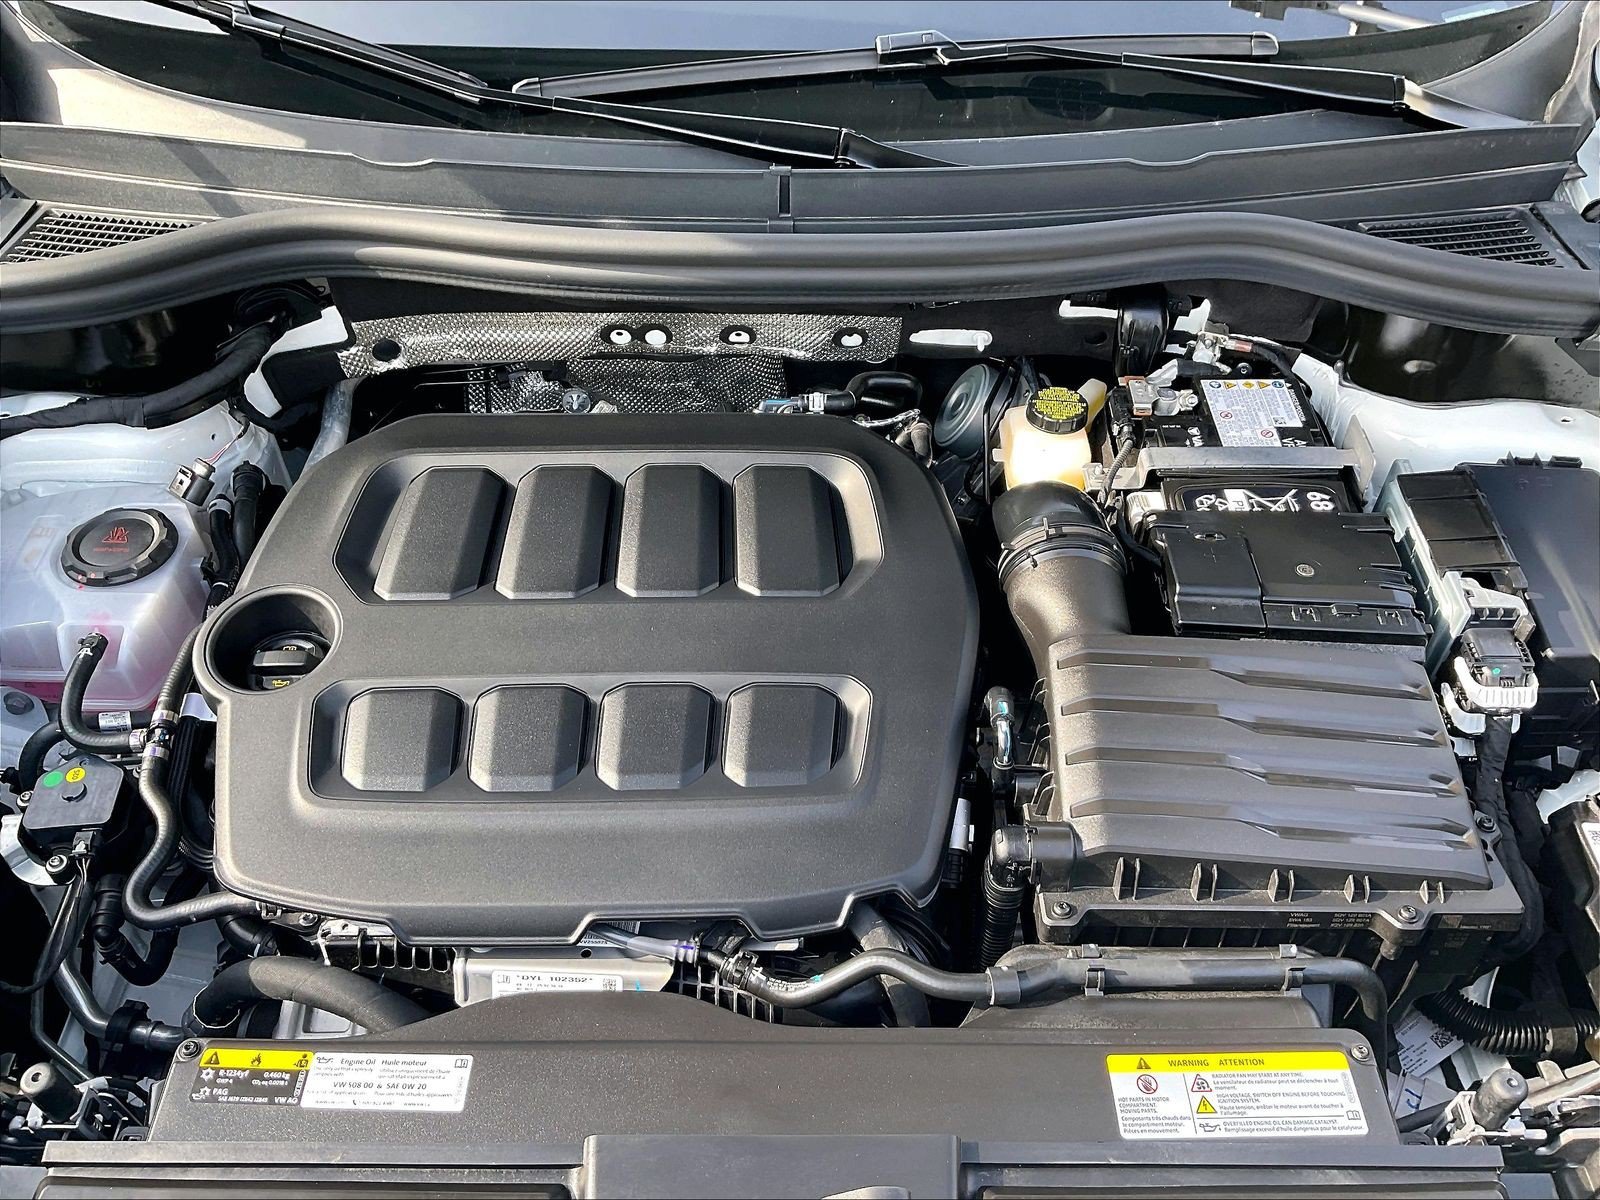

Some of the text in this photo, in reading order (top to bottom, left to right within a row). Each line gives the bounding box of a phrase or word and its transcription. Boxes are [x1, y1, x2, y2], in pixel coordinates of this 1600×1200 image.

[1307, 491, 1335, 511] 68
[219, 1070, 250, 1078] R-1234yf
[282, 1072, 290, 1080] kg
